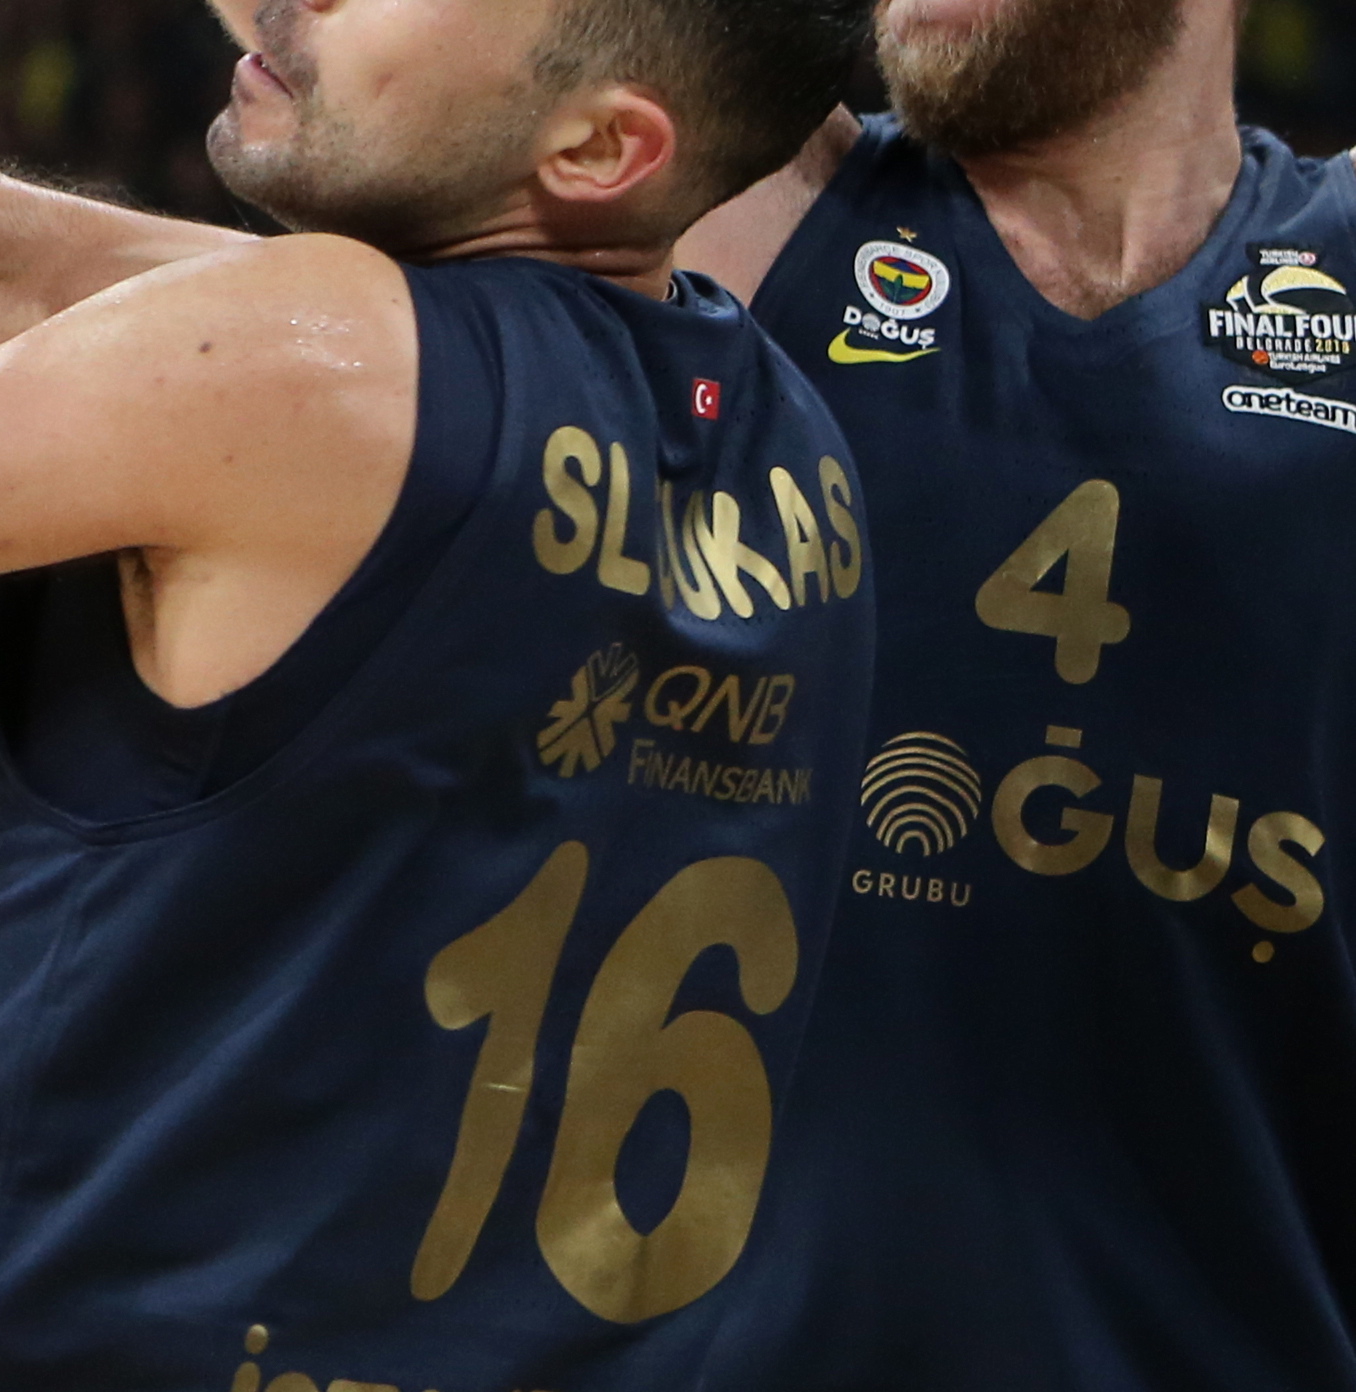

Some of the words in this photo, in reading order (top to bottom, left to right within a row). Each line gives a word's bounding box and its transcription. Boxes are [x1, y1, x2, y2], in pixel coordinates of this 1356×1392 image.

[1208, 309, 1292, 338] FINAL
[1295, 313, 1356, 342] FOU
[975, 479, 1131, 685] 4
[644, 664, 796, 746] QNB
[628, 739, 814, 806] FINANSBANK
[851, 868, 972, 908] GRUBU
[410, 839, 799, 1325] 16
